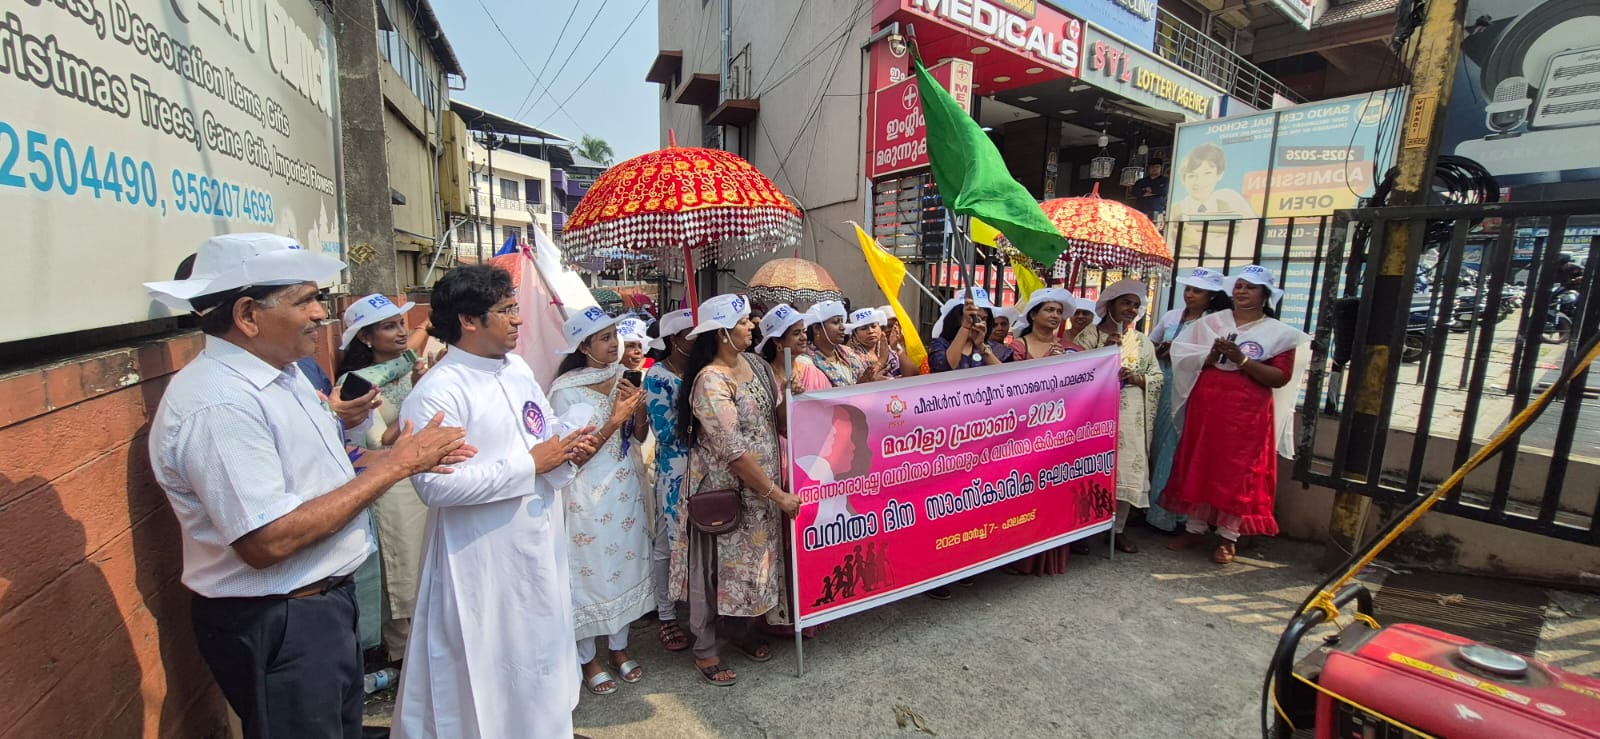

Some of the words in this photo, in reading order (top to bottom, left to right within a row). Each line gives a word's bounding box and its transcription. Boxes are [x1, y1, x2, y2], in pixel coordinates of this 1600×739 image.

[108, 0, 226, 101] Decoration
[225, 67, 266, 128] Items,
[266, 97, 291, 138] Gifts
[1092, 40, 1132, 82] SVL
[1137, 66, 1178, 100] LOTTERY
[1177, 85, 1209, 115] AGENCY
[0, 121, 167, 217] 2504490,
[172, 169, 274, 223] 9562074693
[131, 73, 202, 151] Trees,
[203, 110, 243, 161] Cane
[245, 130, 274, 177] Crib,
[273, 145, 310, 186] Imported
[309, 164, 335, 197] Flowers
[882, 460, 931, 488] വനിതാ
[932, 449, 979, 476] ദിനവും
[991, 438, 1032, 462] വനിതാ
[1033, 430, 1076, 454] കർഷക
[883, 427, 944, 456] മഹിളാ
[1028, 399, 1066, 428] 2026
[803, 512, 877, 551] വനിതാ
[883, 499, 915, 533] ദിന
[925, 469, 1034, 521] സാംസ്കാരിക
[935, 532, 961, 550] 2026
